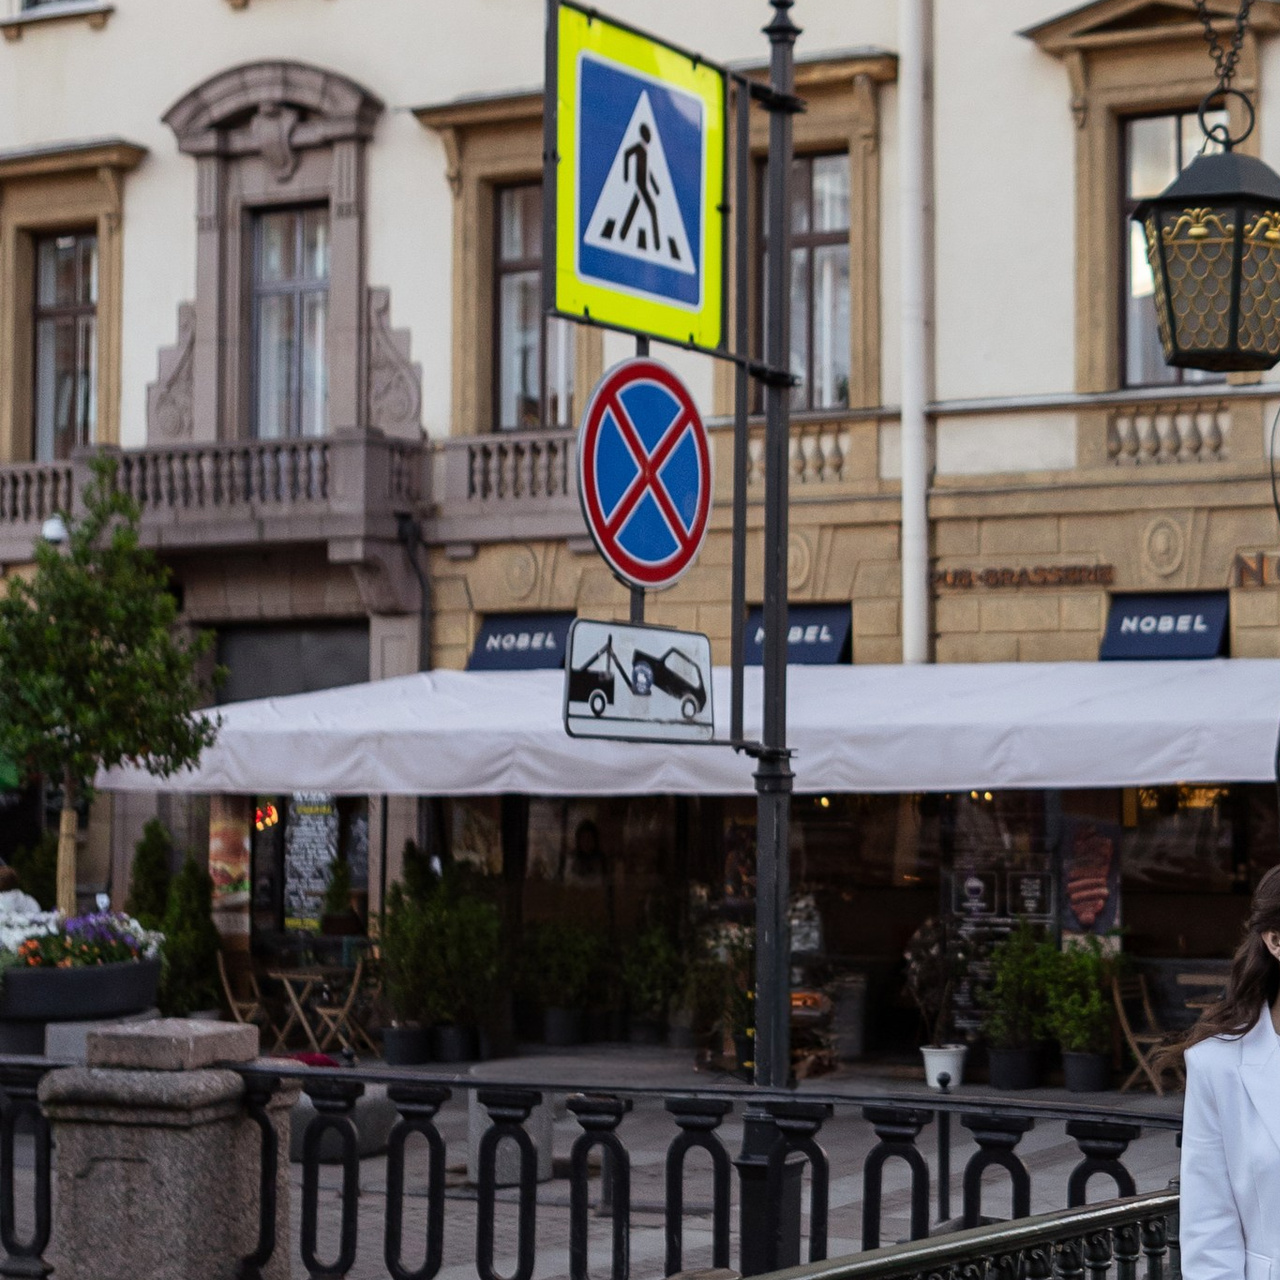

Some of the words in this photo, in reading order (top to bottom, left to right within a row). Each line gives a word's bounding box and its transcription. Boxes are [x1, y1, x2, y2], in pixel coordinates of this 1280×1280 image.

[754, 624, 833, 644] NBEL
[1120, 614, 1208, 634] NOBEL
[485, 631, 557, 651] NOBEL
